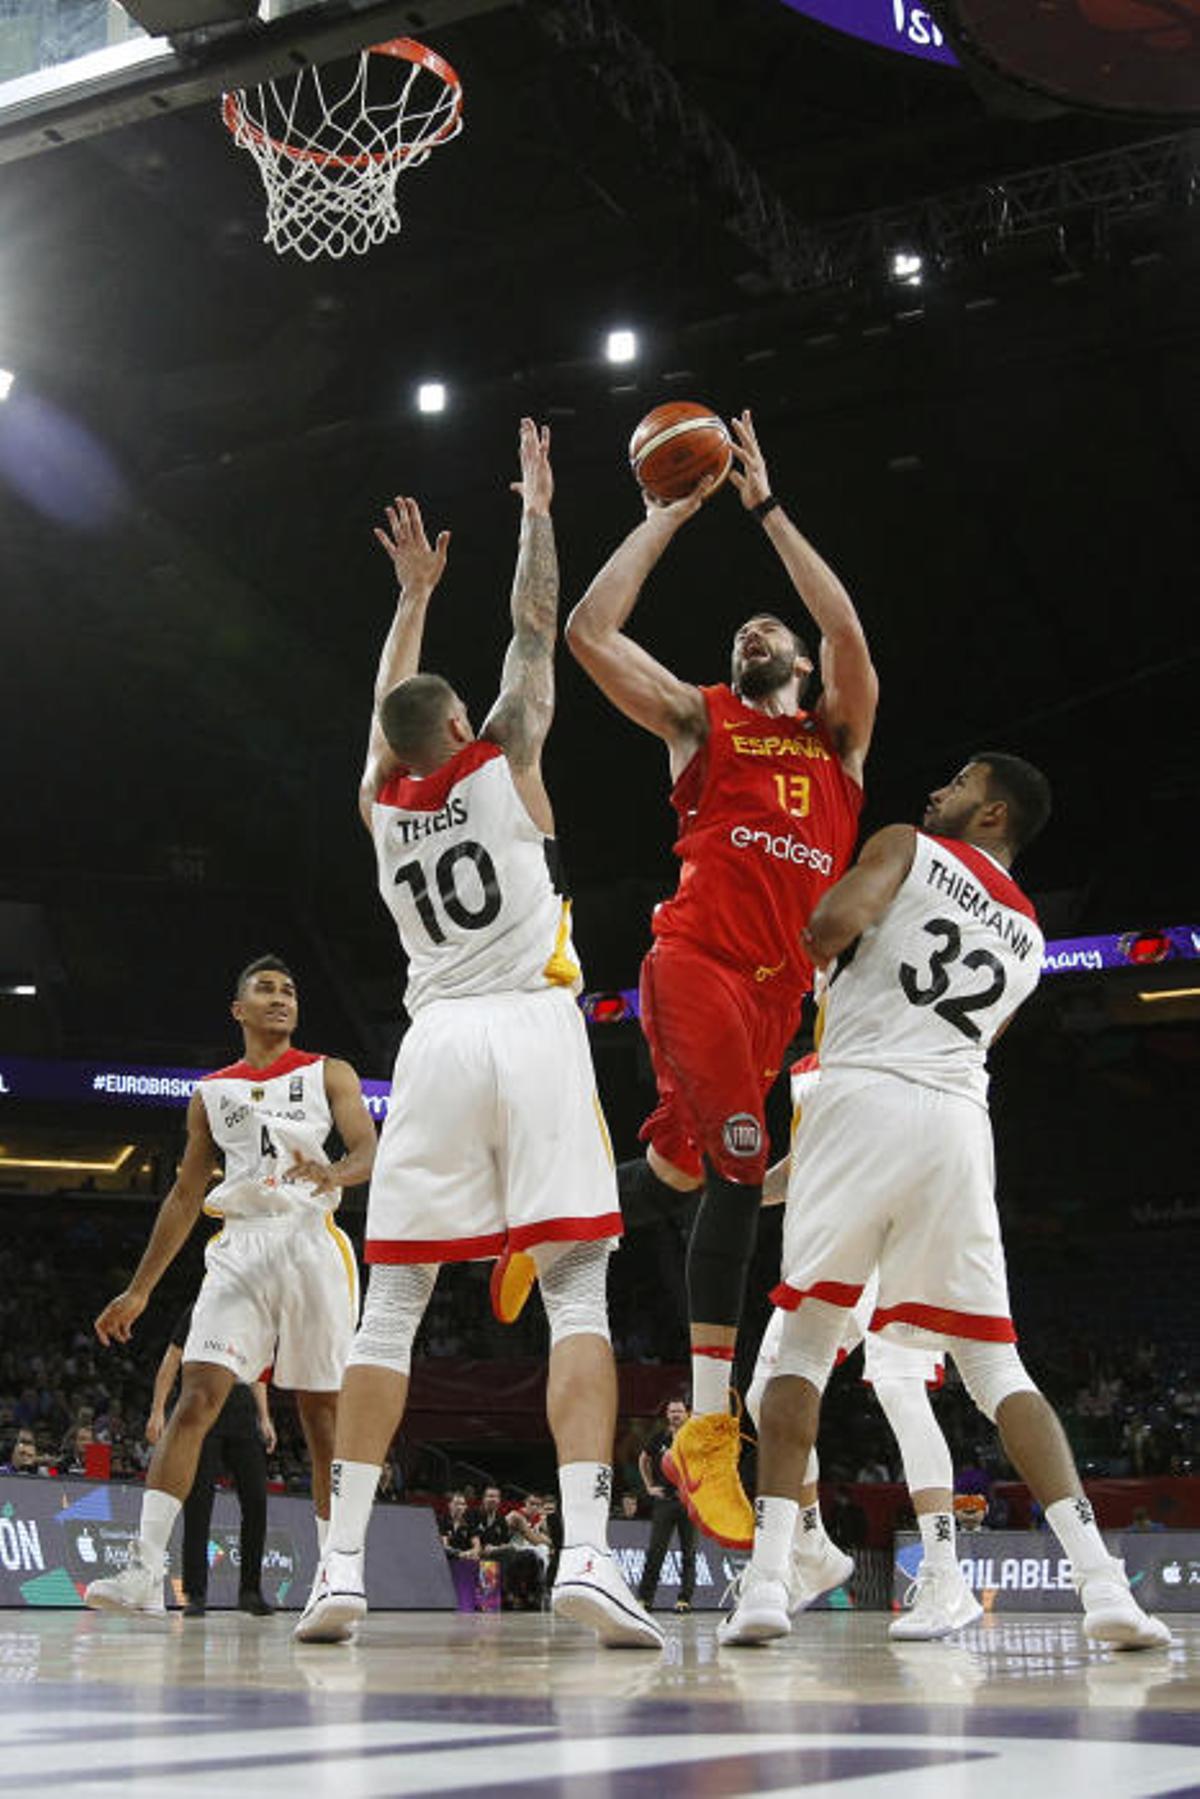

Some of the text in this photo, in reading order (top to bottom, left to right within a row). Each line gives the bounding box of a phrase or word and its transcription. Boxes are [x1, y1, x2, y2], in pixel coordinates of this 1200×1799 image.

[397, 798, 468, 844] THEIS
[773, 774, 810, 817] 13
[730, 825, 834, 876] endesa
[394, 841, 503, 944] 10
[926, 858, 1034, 961] THIEMANN
[899, 918, 1007, 1043] 32
[260, 1124, 278, 1159] 4
